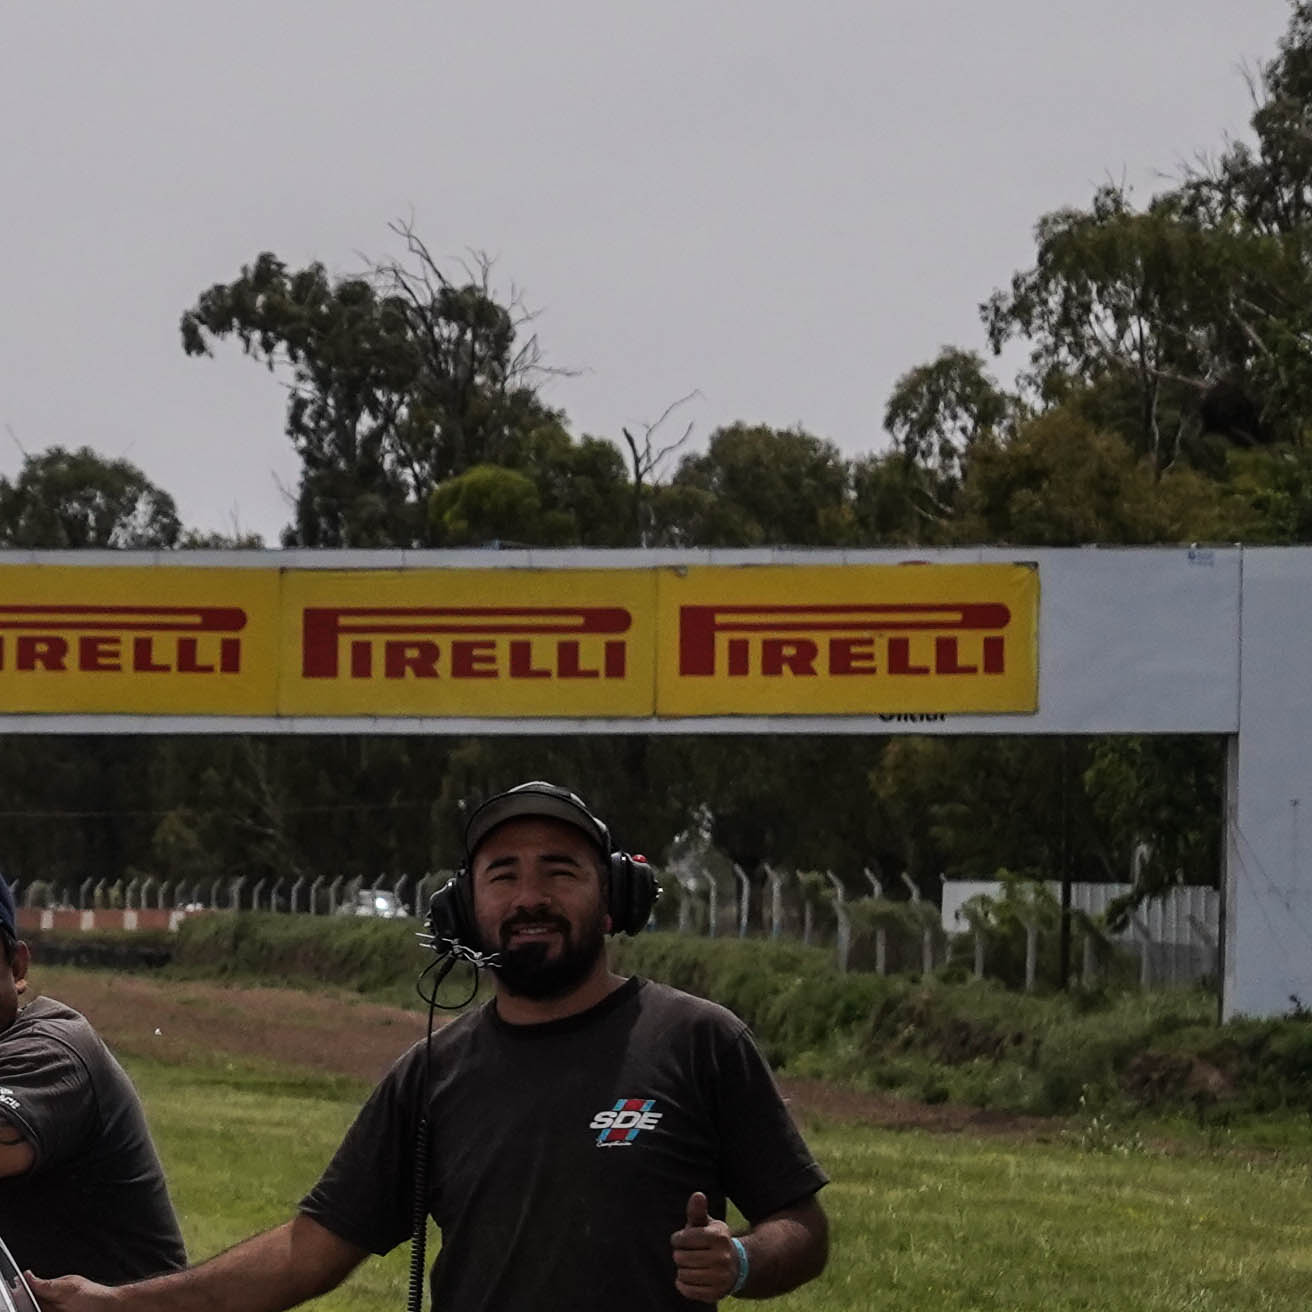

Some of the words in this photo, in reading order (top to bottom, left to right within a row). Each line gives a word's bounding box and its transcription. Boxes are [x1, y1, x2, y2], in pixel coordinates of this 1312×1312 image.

[302, 607, 632, 678] PIRELLI
[679, 603, 1011, 677] PIRELLI
[589, 1110, 664, 1130] SDE
